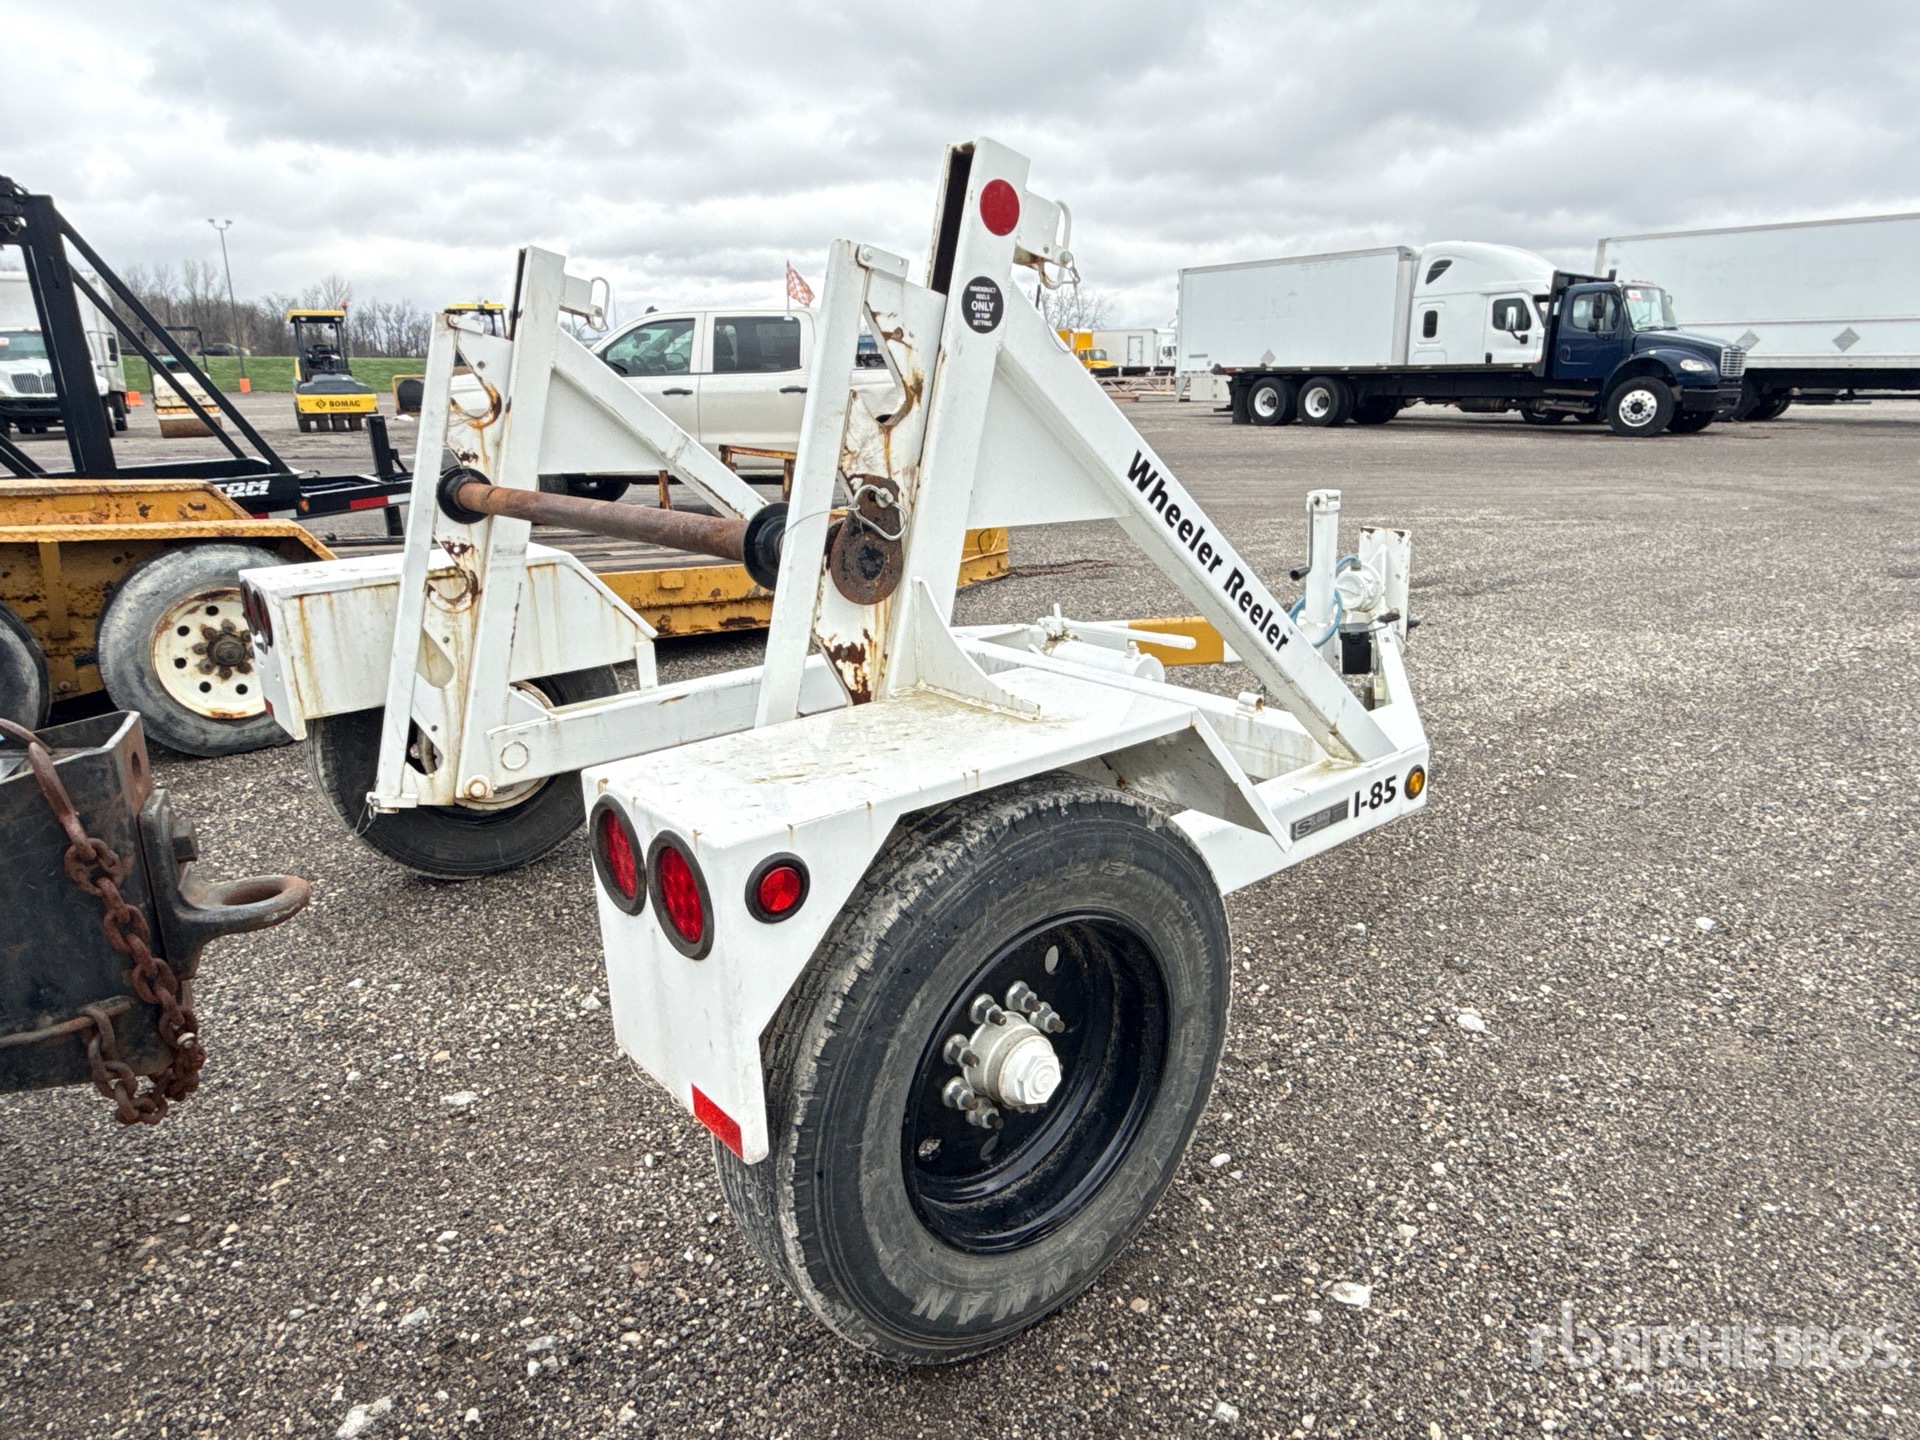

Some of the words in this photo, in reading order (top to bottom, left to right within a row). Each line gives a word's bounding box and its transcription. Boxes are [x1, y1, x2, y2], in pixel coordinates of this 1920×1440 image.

[971, 300, 994, 311] ONLY
[1127, 449, 1223, 573] Wheeler
[1223, 567, 1289, 651] Reeler
[1354, 775, 1396, 818] I-85
